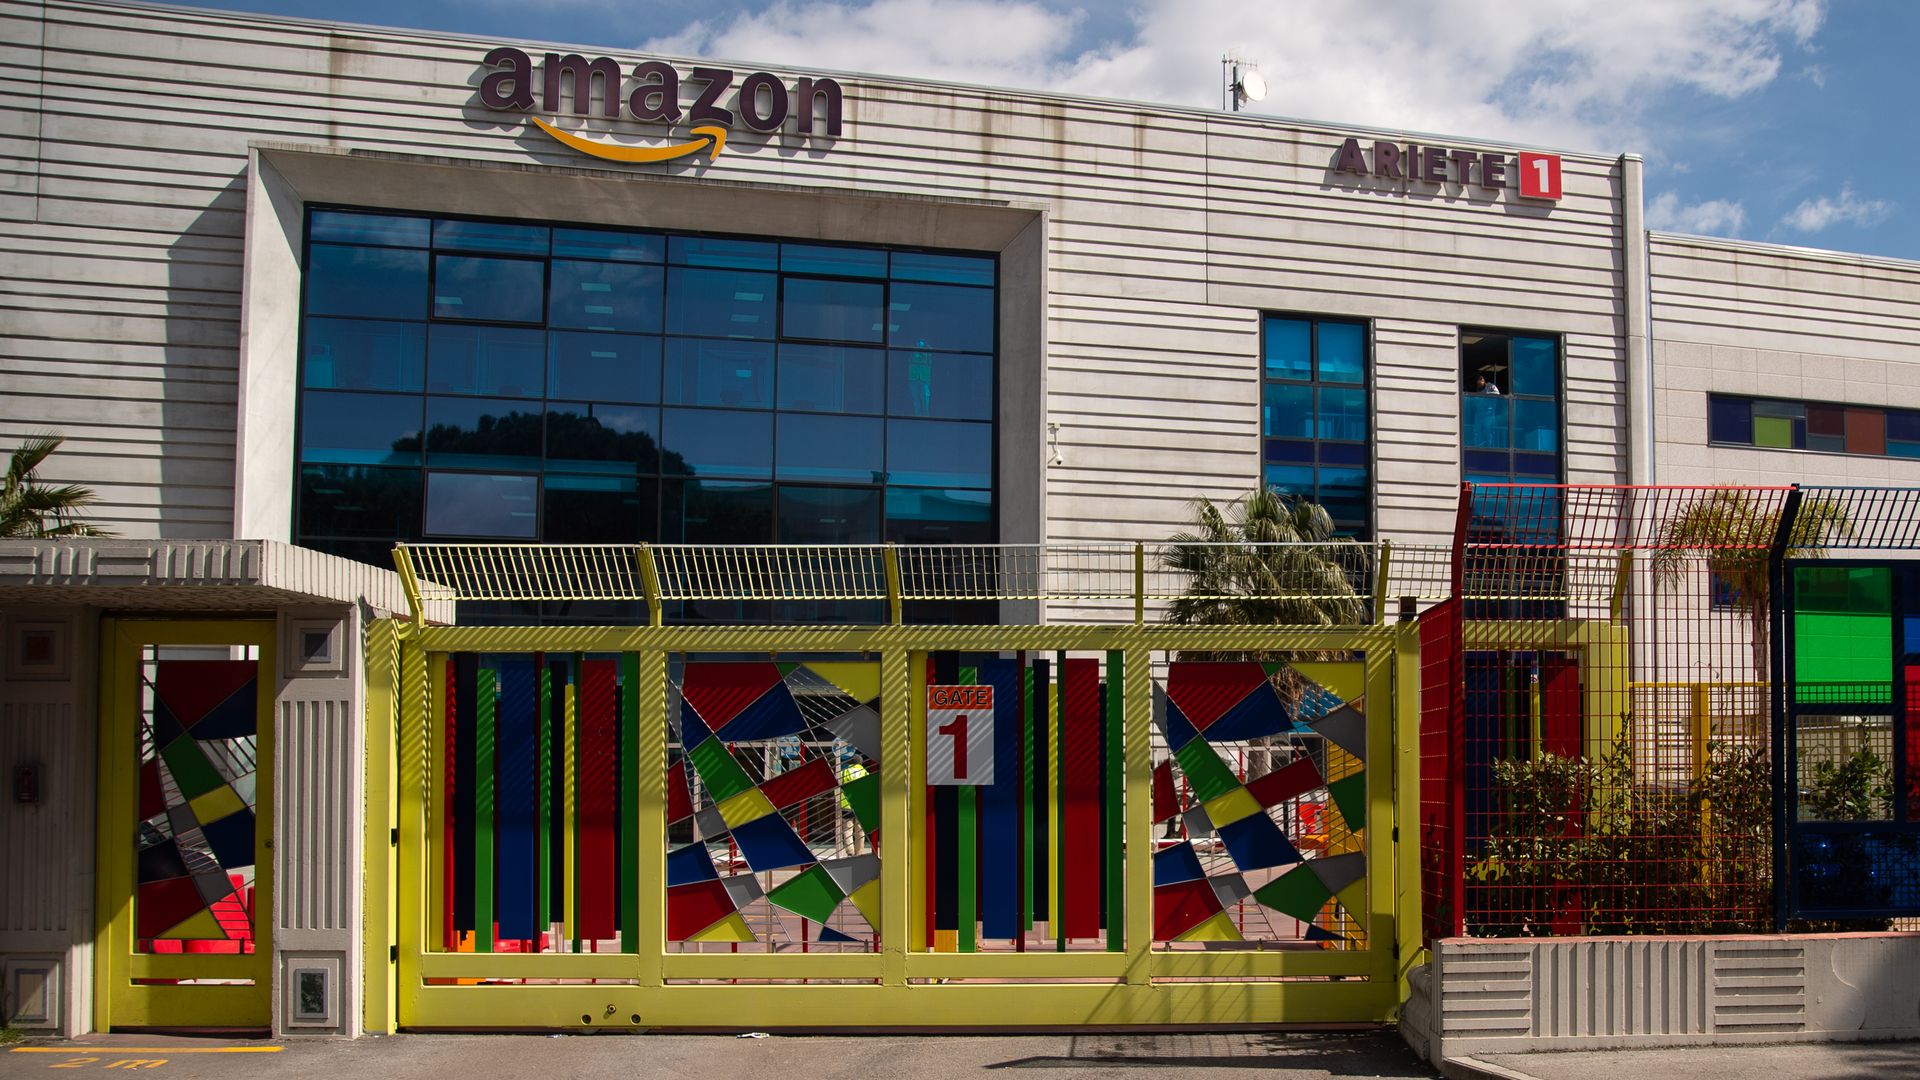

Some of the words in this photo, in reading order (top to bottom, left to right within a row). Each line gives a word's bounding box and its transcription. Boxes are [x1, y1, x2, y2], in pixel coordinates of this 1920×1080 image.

[479, 47, 843, 137] amazon
[1334, 137, 1507, 189] ARIETE
[1532, 159, 1549, 193] 1
[934, 689, 988, 706] GATE
[938, 714, 968, 780] 1
